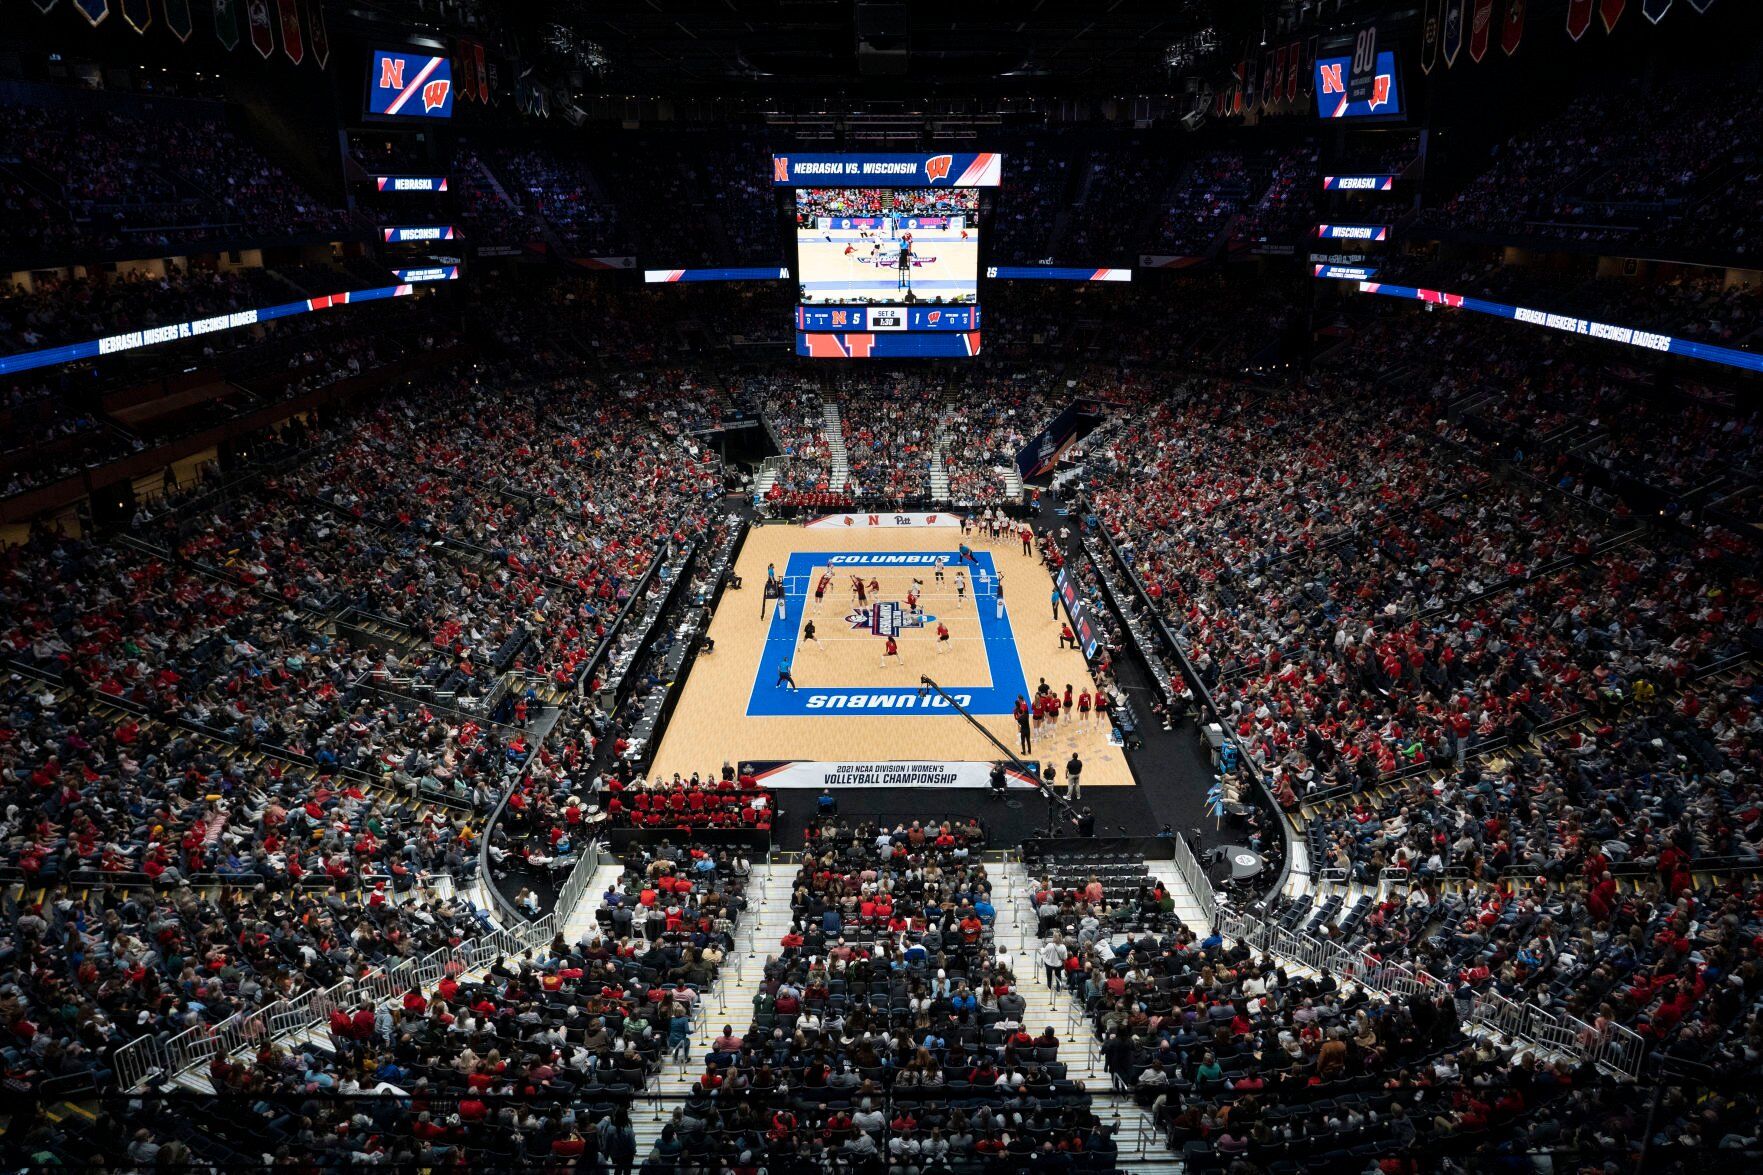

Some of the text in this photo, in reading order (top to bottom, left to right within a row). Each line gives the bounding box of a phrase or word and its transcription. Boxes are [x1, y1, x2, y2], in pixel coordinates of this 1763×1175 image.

[1353, 26, 1376, 74] 80
[380, 57, 405, 90] N
[1320, 63, 1346, 94] N
[422, 80, 451, 114] W
[774, 157, 789, 182] N
[794, 162, 918, 174] NEBRASKA VS. WISCONSIN
[925, 155, 953, 184] W
[395, 178, 433, 190] NEBRASKA
[1338, 178, 1376, 189] NEBRASKA
[400, 228, 440, 241] WISCONSIN
[1332, 227, 1372, 239] WISCONSIN
[832, 310, 847, 325] N
[852, 313, 861, 325] 5
[915, 313, 920, 325] 1
[928, 311, 941, 324] W
[98, 309, 258, 355] NEBRASKA HUSKERS VS. WISCONSIN BADGERS
[1513, 307, 1672, 352] NEBRASKA HUSKERS VS. WISCONSIN BADGERS
[868, 515, 879, 526] N
[894, 515, 912, 525] Pitt
[831, 555, 951, 564] COLUMBUS
[806, 694, 972, 708] COLUMBUS
[837, 765, 945, 773] 2021 NCAA DIVISION I WOMEN'S
[824, 773, 958, 784] VOLLEYBALL CHAMPIONSHIP
